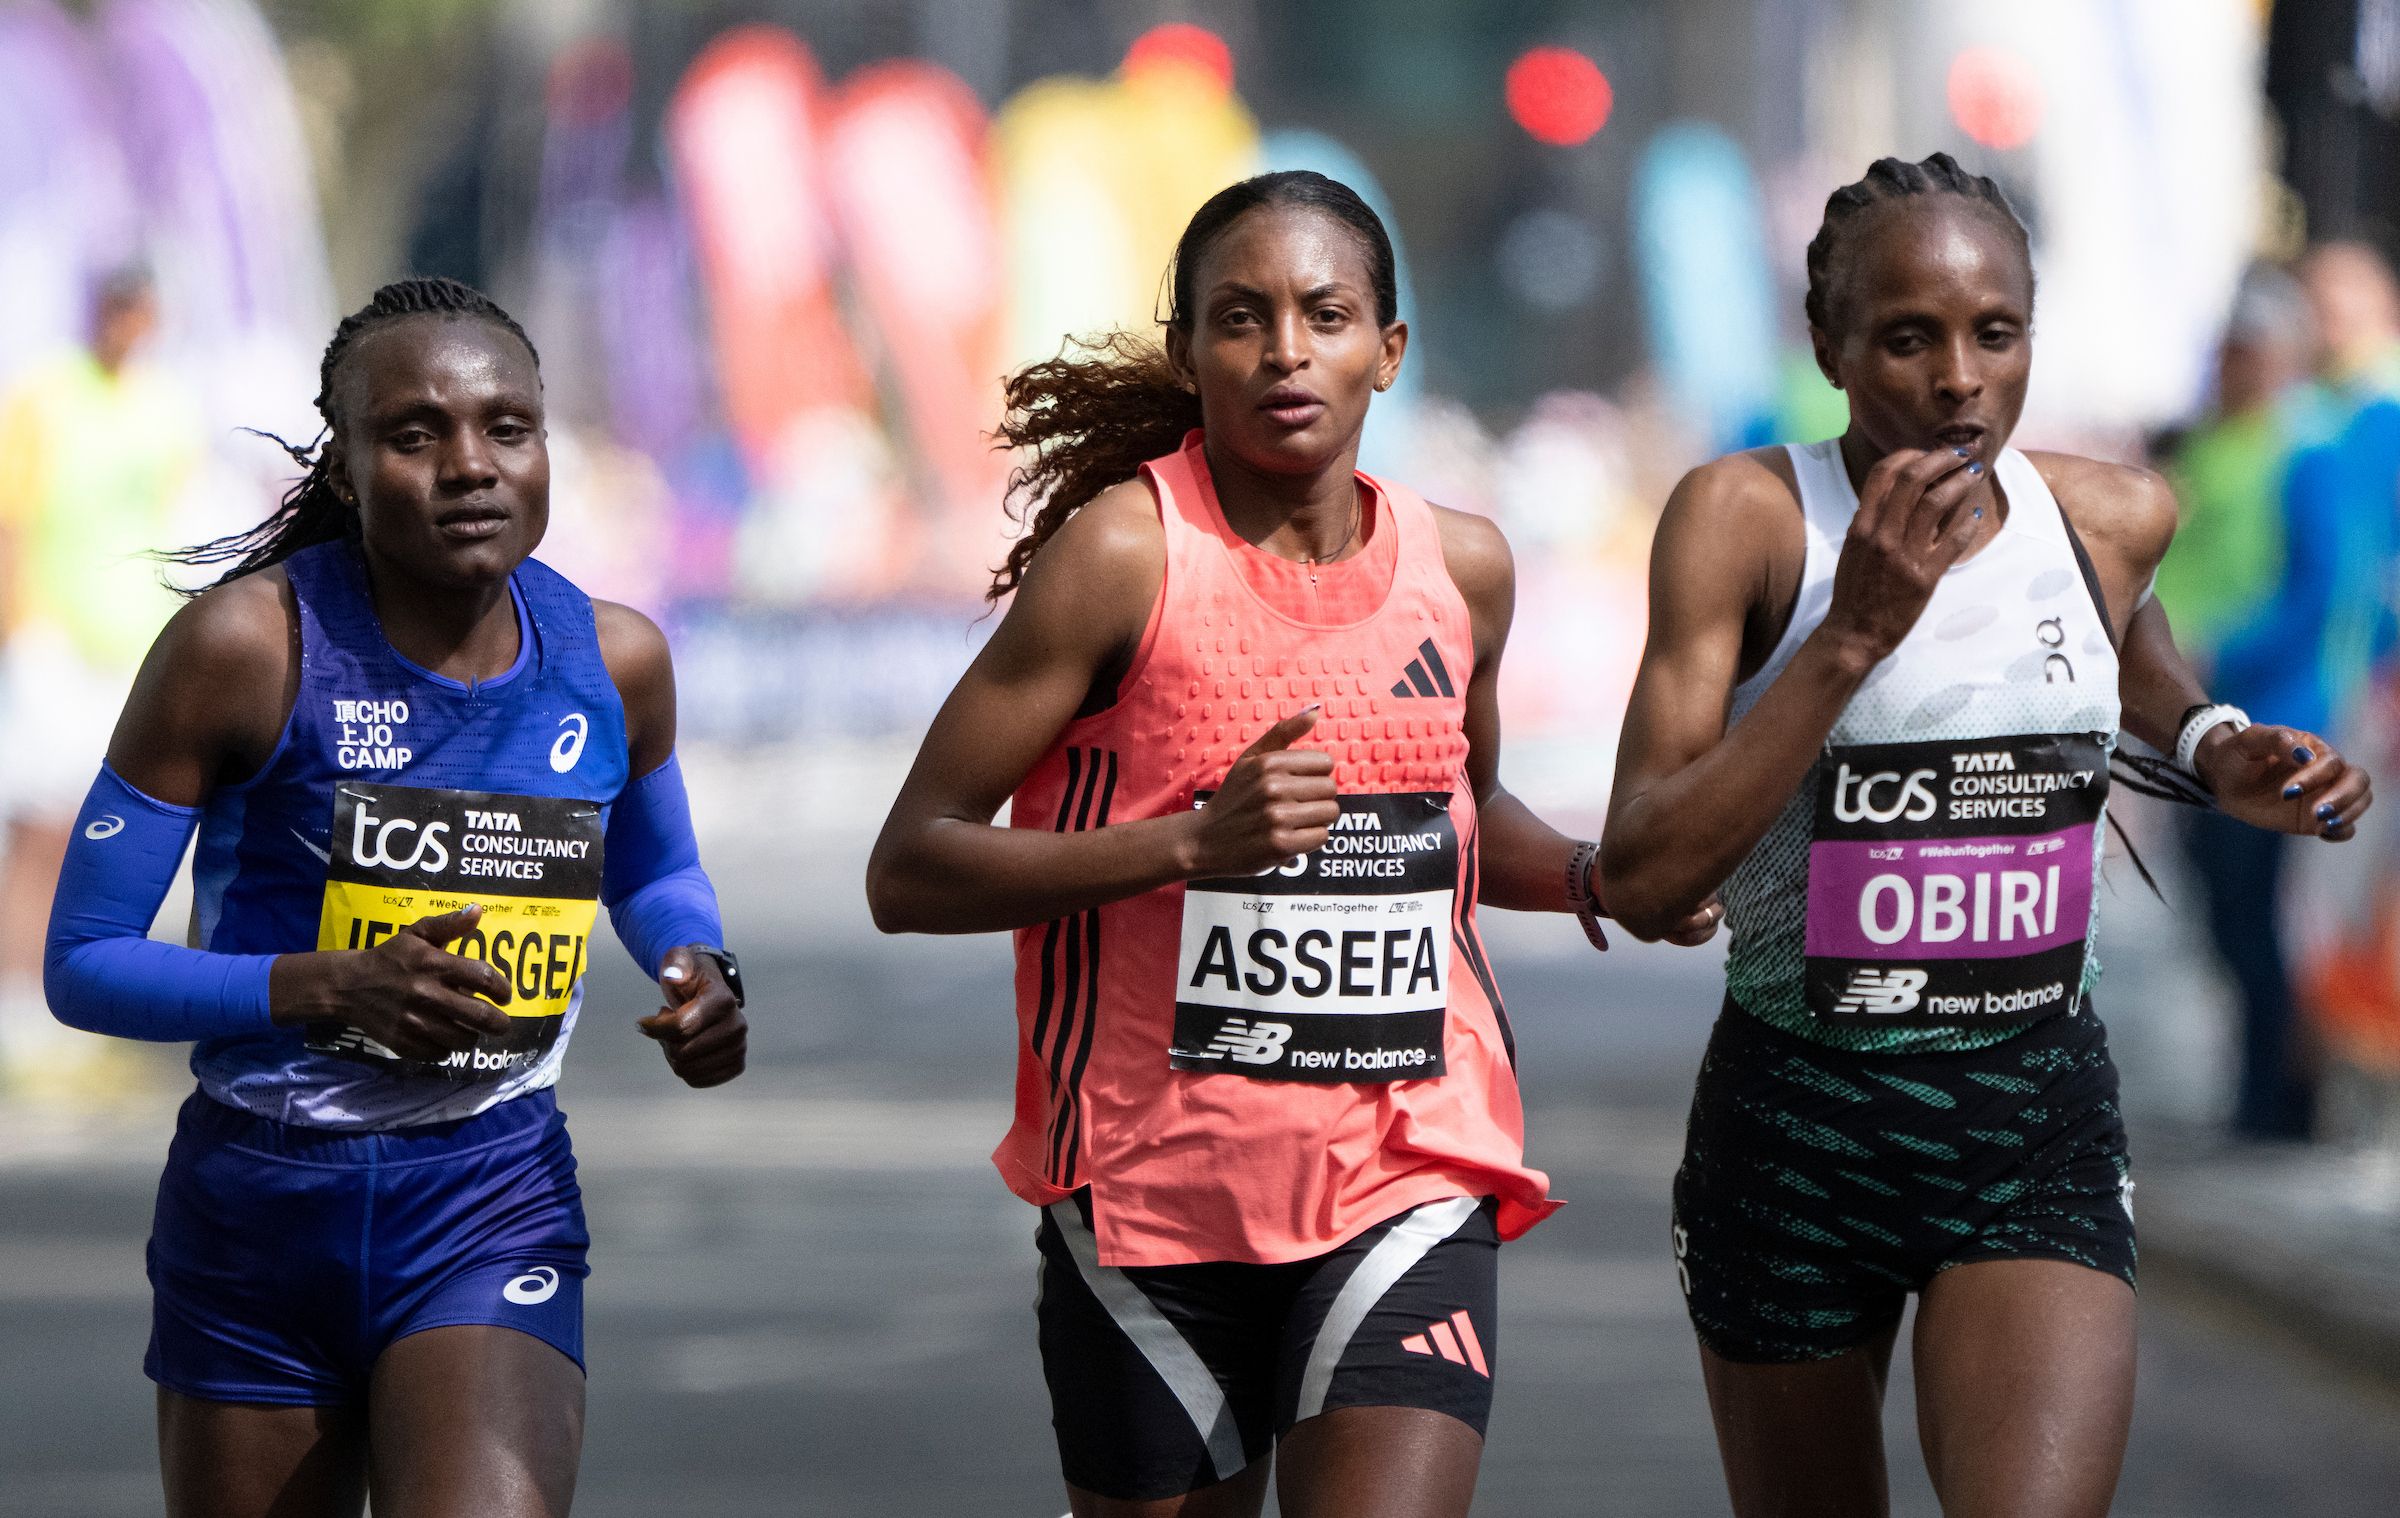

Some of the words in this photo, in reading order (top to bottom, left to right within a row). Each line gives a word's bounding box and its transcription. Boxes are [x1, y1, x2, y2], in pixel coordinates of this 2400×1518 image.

[338, 747, 412, 770] CAMP
[1951, 752, 2015, 773] TATA
[1834, 762, 1938, 824] tcs
[1949, 770, 2094, 796] CONSULTANCY
[1949, 798, 2047, 820] SERVICES
[464, 810, 522, 832] TATA
[1327, 812, 1382, 831] ATA
[352, 802, 450, 872] tcs
[461, 834, 590, 859] CONSULTANCY
[1321, 833, 1441, 854] CONSULTANCY
[1919, 844, 2016, 858] #WeRunTogether
[459, 857, 545, 880] SERVICES
[1320, 858, 1406, 877] SERVICES
[429, 899, 513, 914] #WeRungether
[1242, 901, 1258, 911] tcs
[1290, 903, 1378, 915] #WeRunTogether
[1859, 865, 2061, 945] OBIRI
[1189, 925, 1440, 998] ASSEFA
[1927, 997, 1979, 1015] new
[1984, 981, 2065, 1014] balance
[1291, 1050, 1339, 1069] new
[1344, 1047, 1427, 1070] balance
